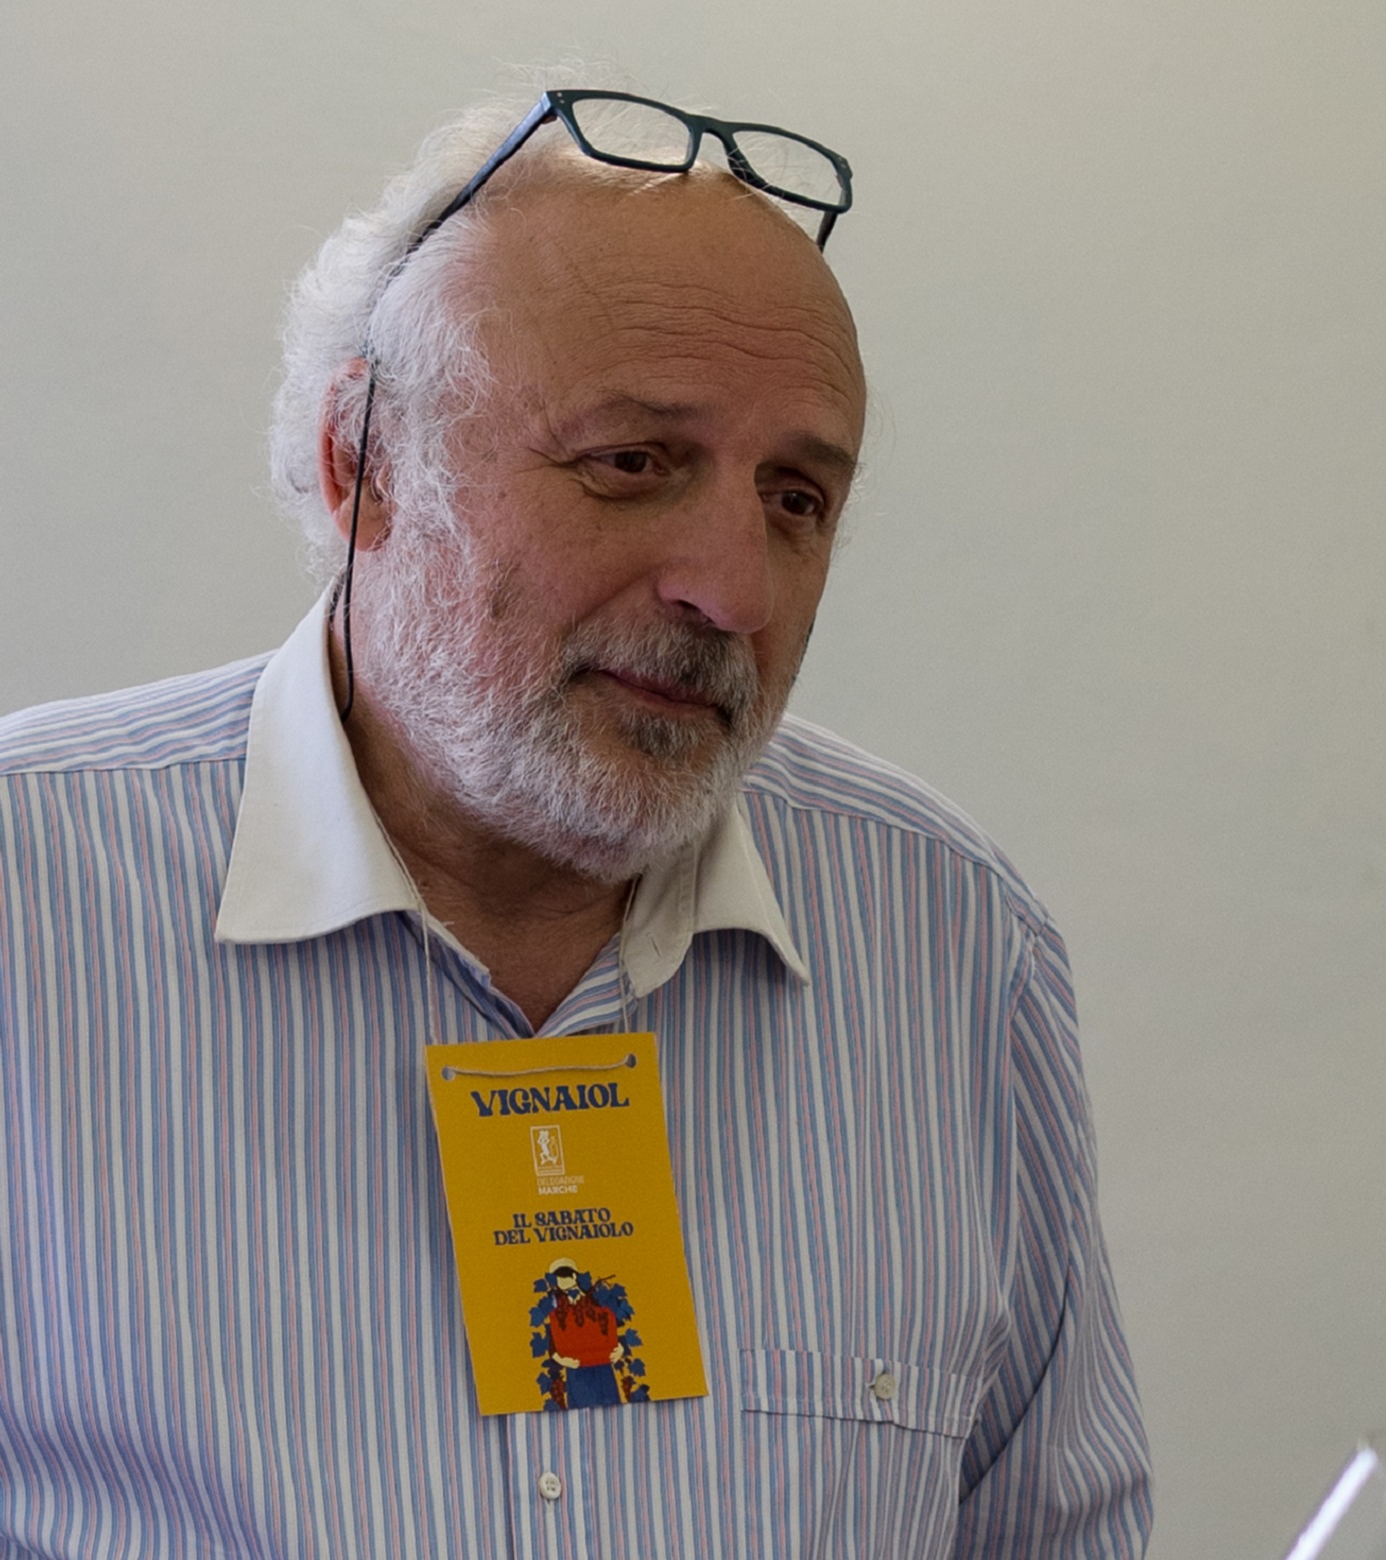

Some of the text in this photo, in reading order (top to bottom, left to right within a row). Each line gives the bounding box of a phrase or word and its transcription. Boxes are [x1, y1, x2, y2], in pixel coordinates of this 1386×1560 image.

[470, 1082, 630, 1118] VIGNAIOL
[538, 1185, 579, 1196] MARCHE
[513, 1207, 611, 1229] IL SABATO
[494, 1221, 634, 1246] DEL VIGNAIOLO
